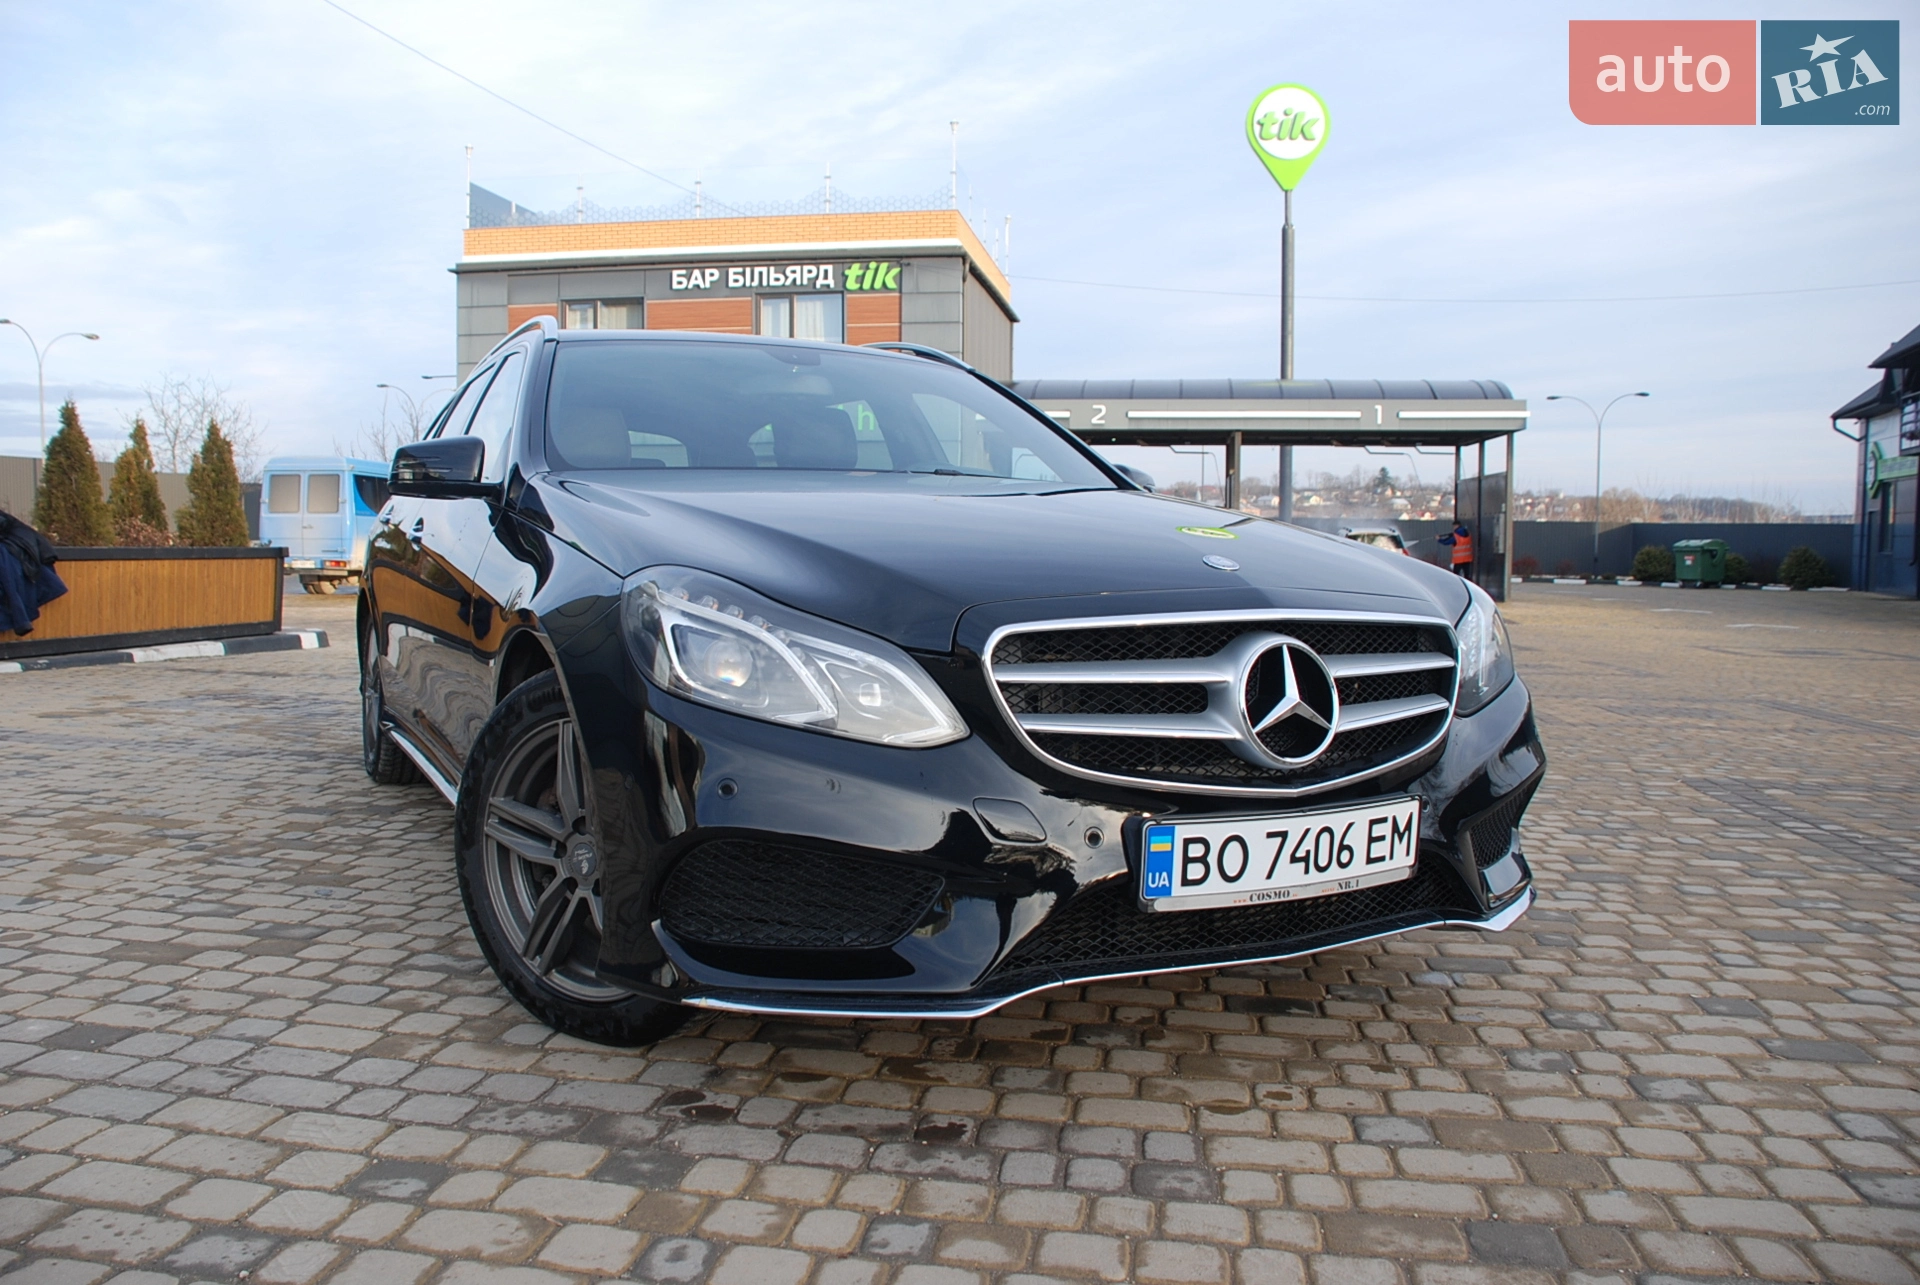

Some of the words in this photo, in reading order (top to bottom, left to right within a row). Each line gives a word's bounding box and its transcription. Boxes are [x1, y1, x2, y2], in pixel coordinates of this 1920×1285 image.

[1256, 107, 1320, 141] tik
[671, 268, 720, 291] БАР
[727, 264, 835, 290] БІЛЬЯРД
[844, 261, 901, 291] tik
[1090, 404, 1107, 425] 2
[1374, 404, 1383, 425] 1
[1148, 871, 1170, 889] UA
[1180, 834, 1249, 887] BO
[1265, 822, 1355, 880] 7406
[1365, 811, 1413, 865] EM
[1249, 889, 1291, 903] COSMO
